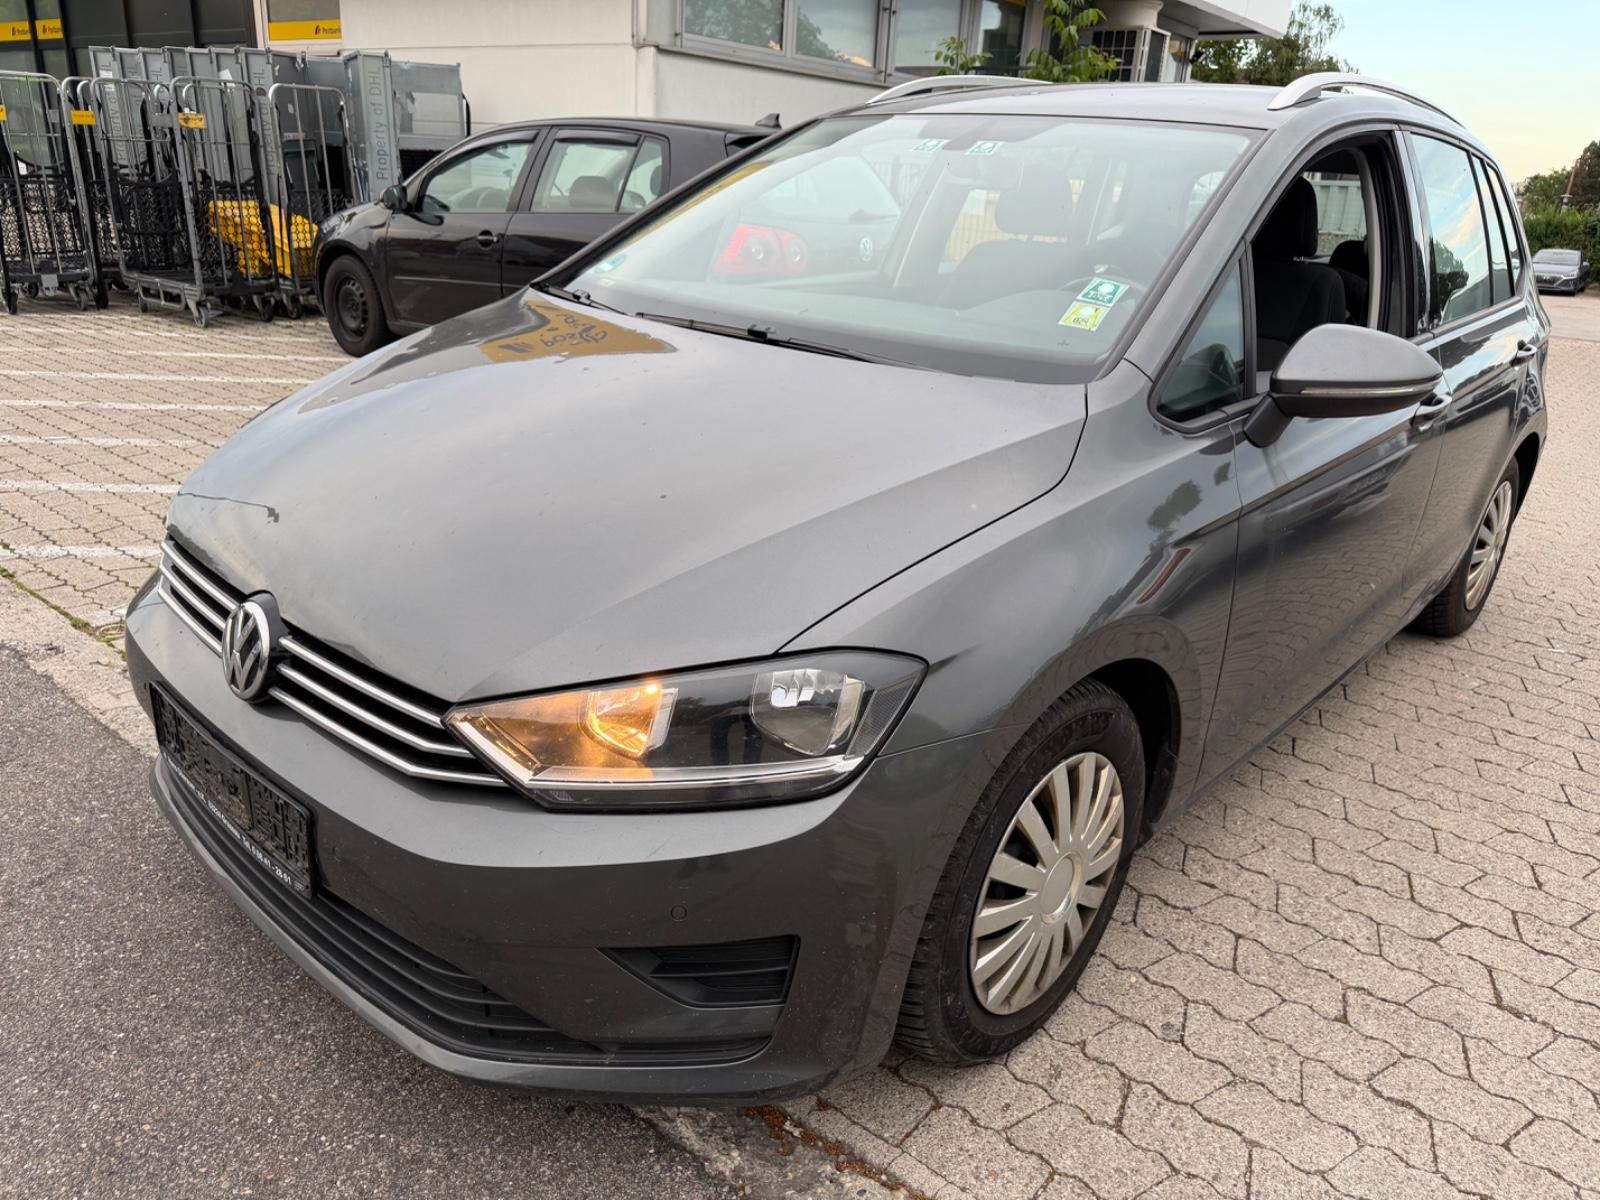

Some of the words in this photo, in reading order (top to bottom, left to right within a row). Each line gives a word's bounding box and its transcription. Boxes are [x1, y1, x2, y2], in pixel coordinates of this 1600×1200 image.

[367, 67, 382, 96] DHL
[369, 102, 383, 116] of
[373, 121, 389, 181] Property
